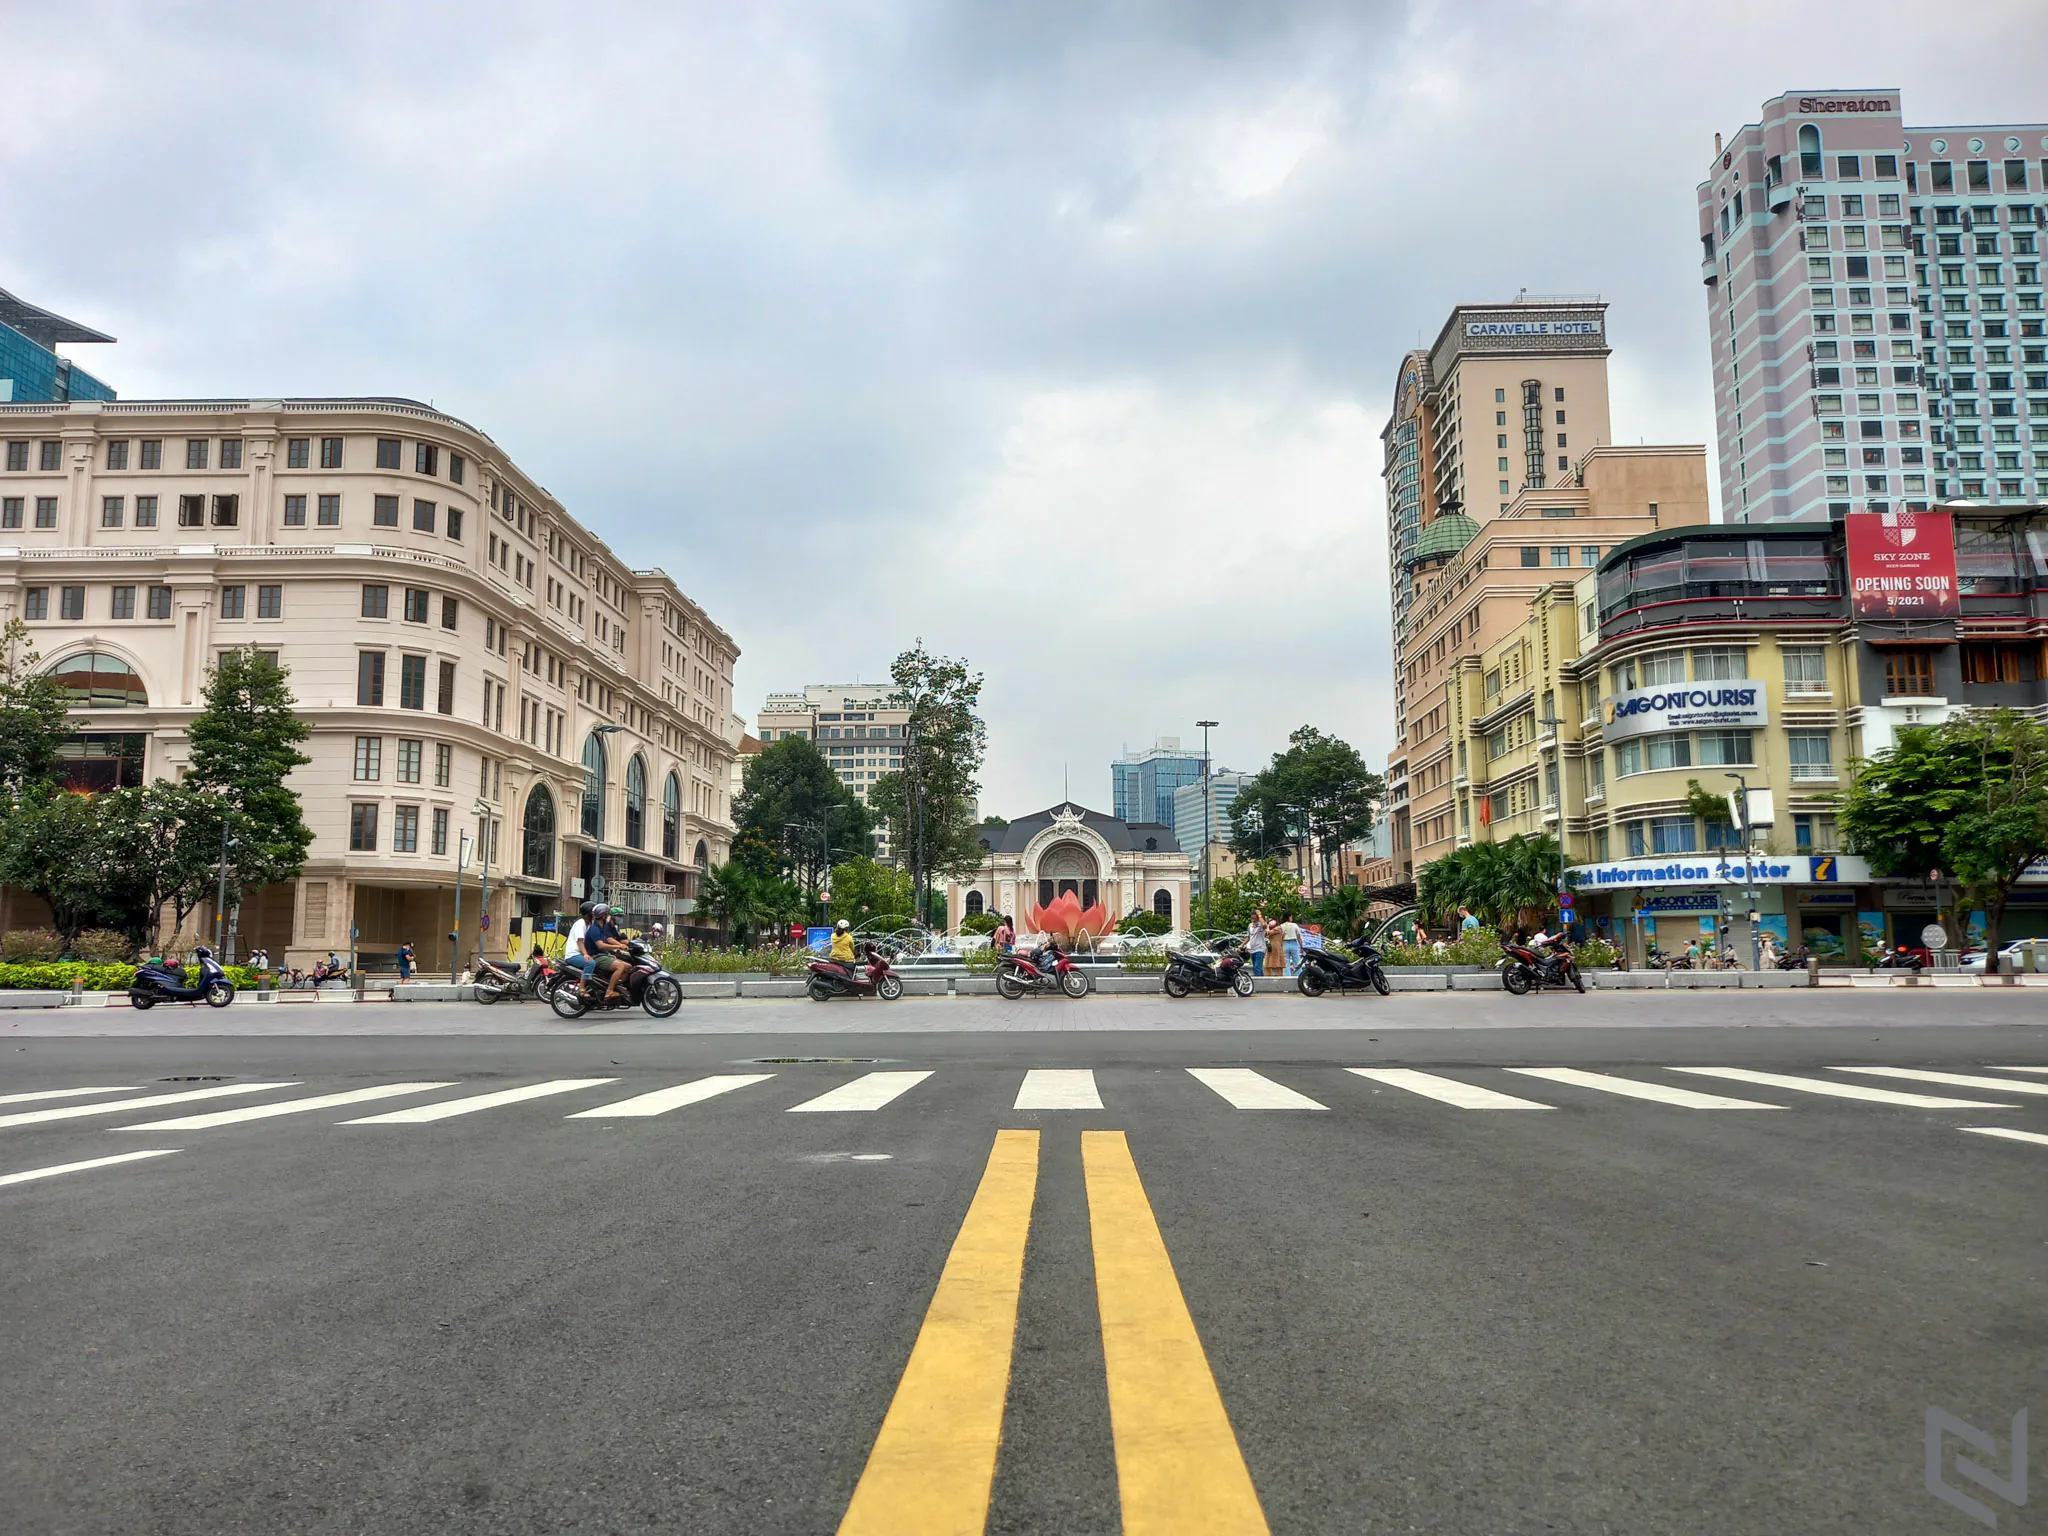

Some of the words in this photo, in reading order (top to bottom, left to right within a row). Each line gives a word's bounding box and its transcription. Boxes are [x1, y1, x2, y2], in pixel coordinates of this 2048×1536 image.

[1799, 98, 1891, 113] Sheraton
[1470, 323, 1548, 335] CARAVELLE
[1553, 322, 1598, 333] HOTEL
[1873, 553, 1896, 561] SKY
[1898, 552, 1931, 561] ZONE
[1855, 577, 1912, 591] OPENING
[1915, 576, 1950, 590] SOON
[1887, 596, 1925, 606] 5/2021
[1616, 689, 1757, 718] SAIGONTOURIST
[1596, 864, 1709, 884] Information
